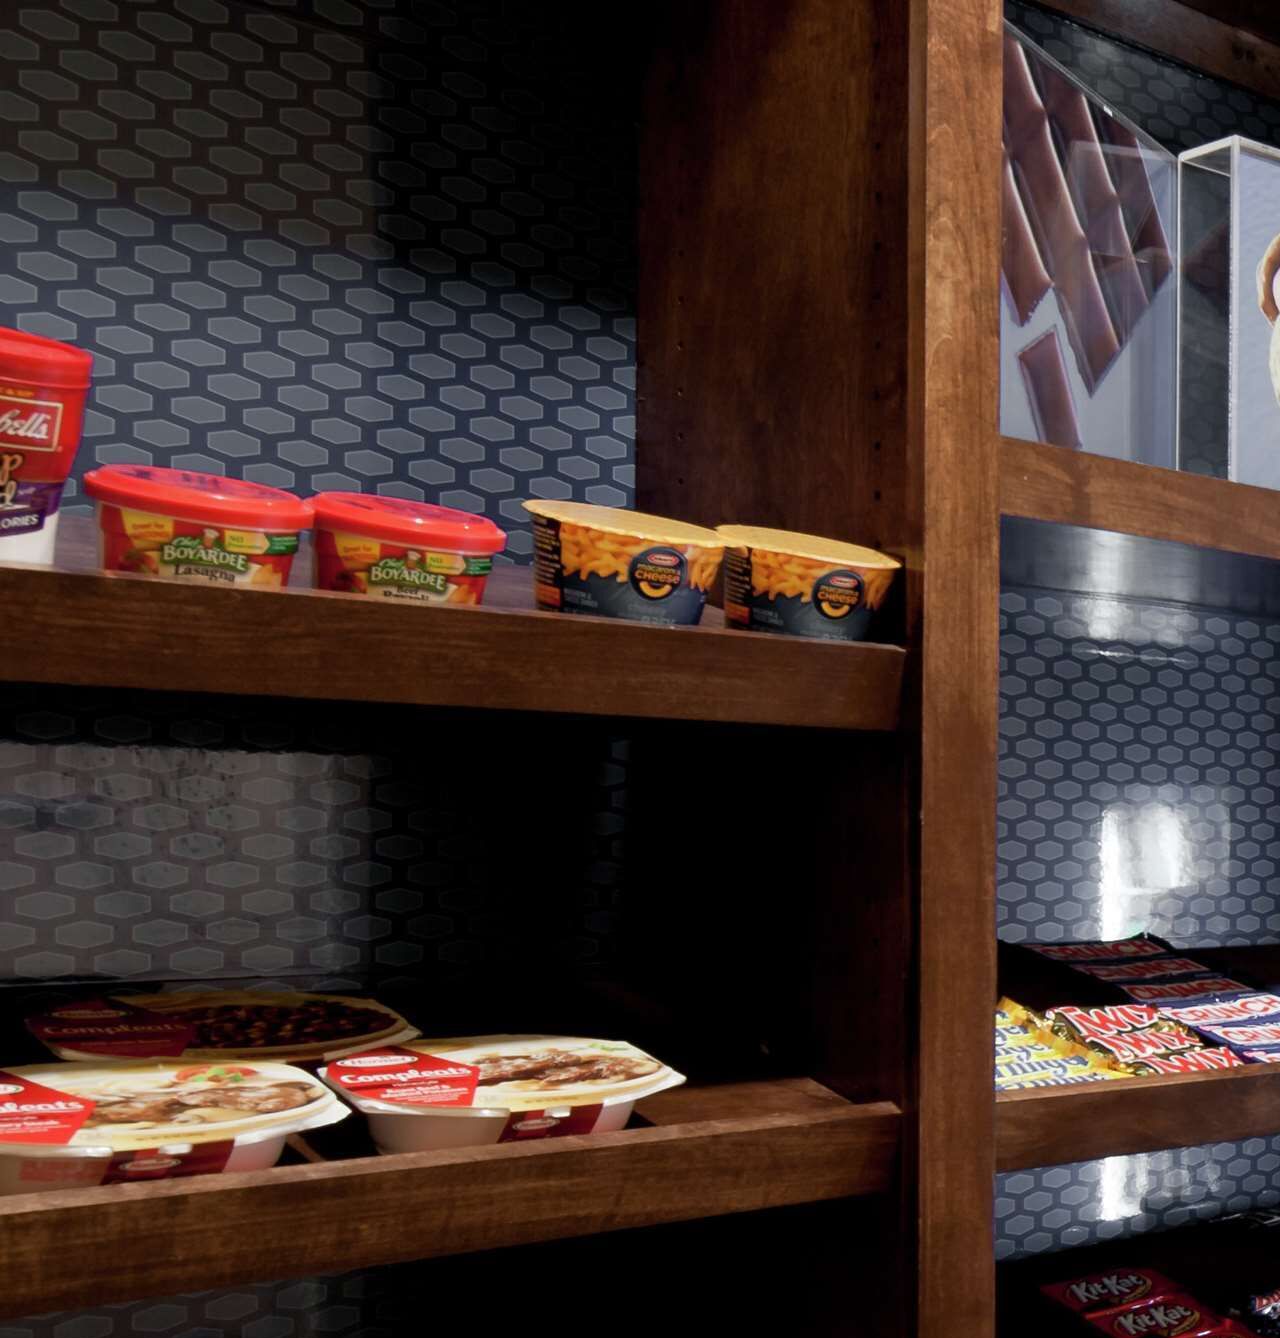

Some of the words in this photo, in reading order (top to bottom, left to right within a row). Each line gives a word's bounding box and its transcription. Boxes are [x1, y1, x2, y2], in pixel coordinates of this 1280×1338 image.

[0, 409, 49, 439] bell's
[1, 513, 39, 528] ORIES
[163, 543, 248, 571] BOYARDEE
[174, 564, 236, 583] Lasagna
[371, 566, 446, 591] BOYARDEE
[1129, 979, 1244, 998] CRUNCH
[1052, 1005, 1158, 1037] TWIX
[1087, 1029, 1202, 1061] TWIX
[1138, 1046, 1244, 1074] TWIX
[340, 1067, 472, 1084] Compleats
